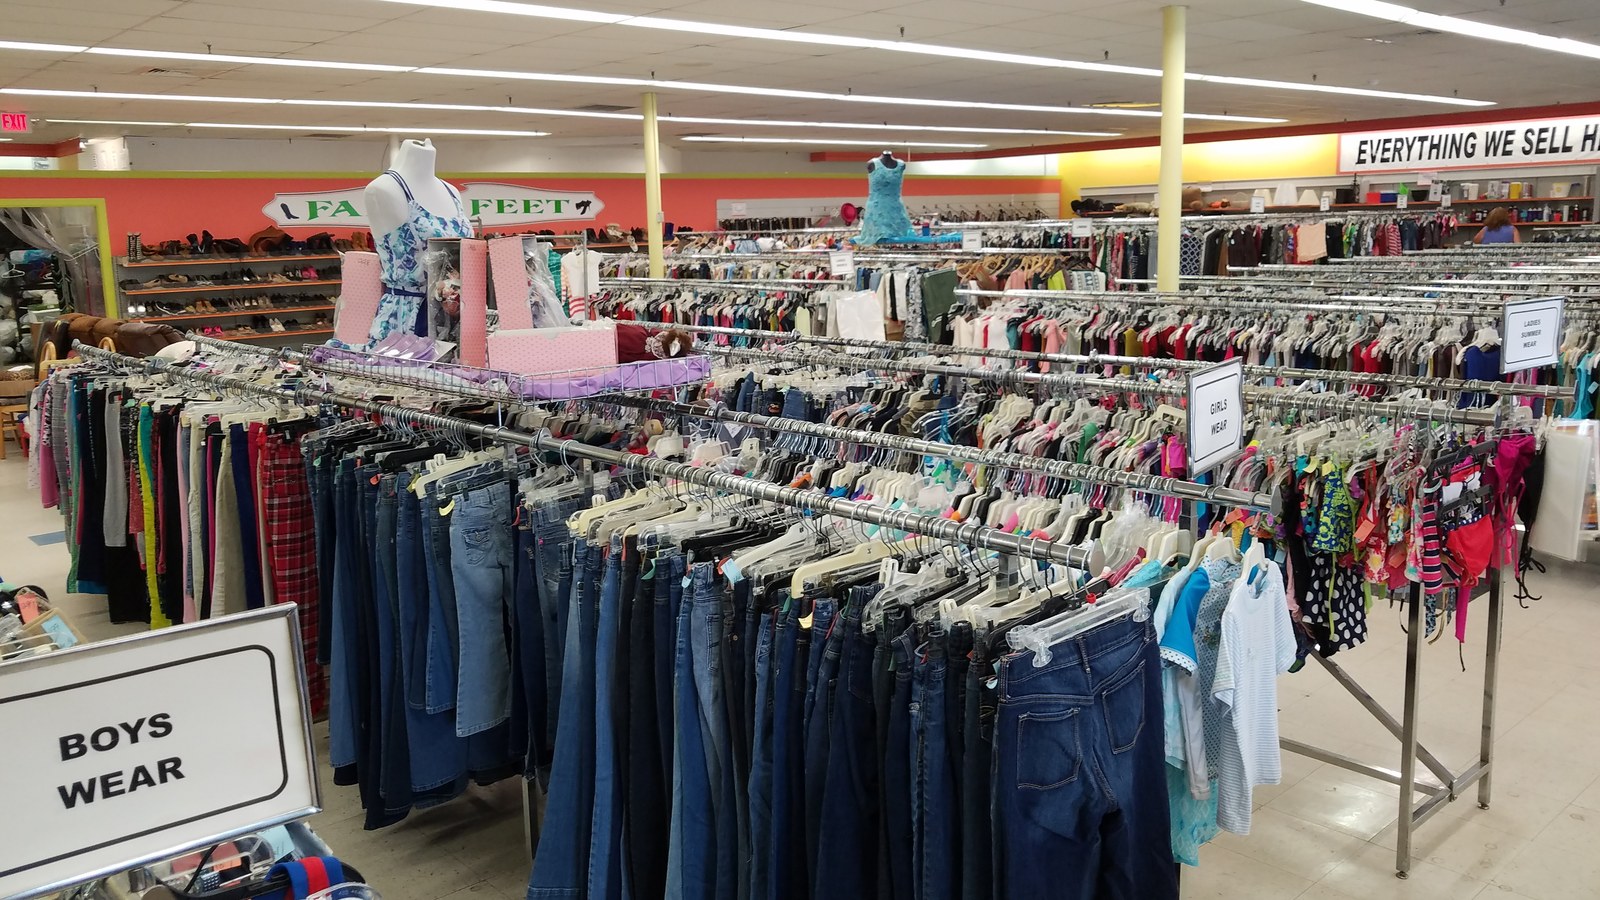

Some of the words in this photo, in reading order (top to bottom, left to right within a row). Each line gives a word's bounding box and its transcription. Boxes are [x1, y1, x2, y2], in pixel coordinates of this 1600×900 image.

[1, 113, 26, 131] EXIT
[1355, 132, 1477, 164] EVERYTHING
[1484, 130, 1516, 157] WE
[1521, 125, 1573, 156] SELL
[1581, 124, 1600, 152] H
[305, 200, 368, 221] FA
[469, 199, 570, 217] FEET
[1521, 330, 1541, 338] SUMMER
[1210, 398, 1228, 415] GIRLS
[1210, 419, 1228, 435] WEAR
[59, 713, 173, 761] BOYS
[57, 757, 185, 809] WEAR
